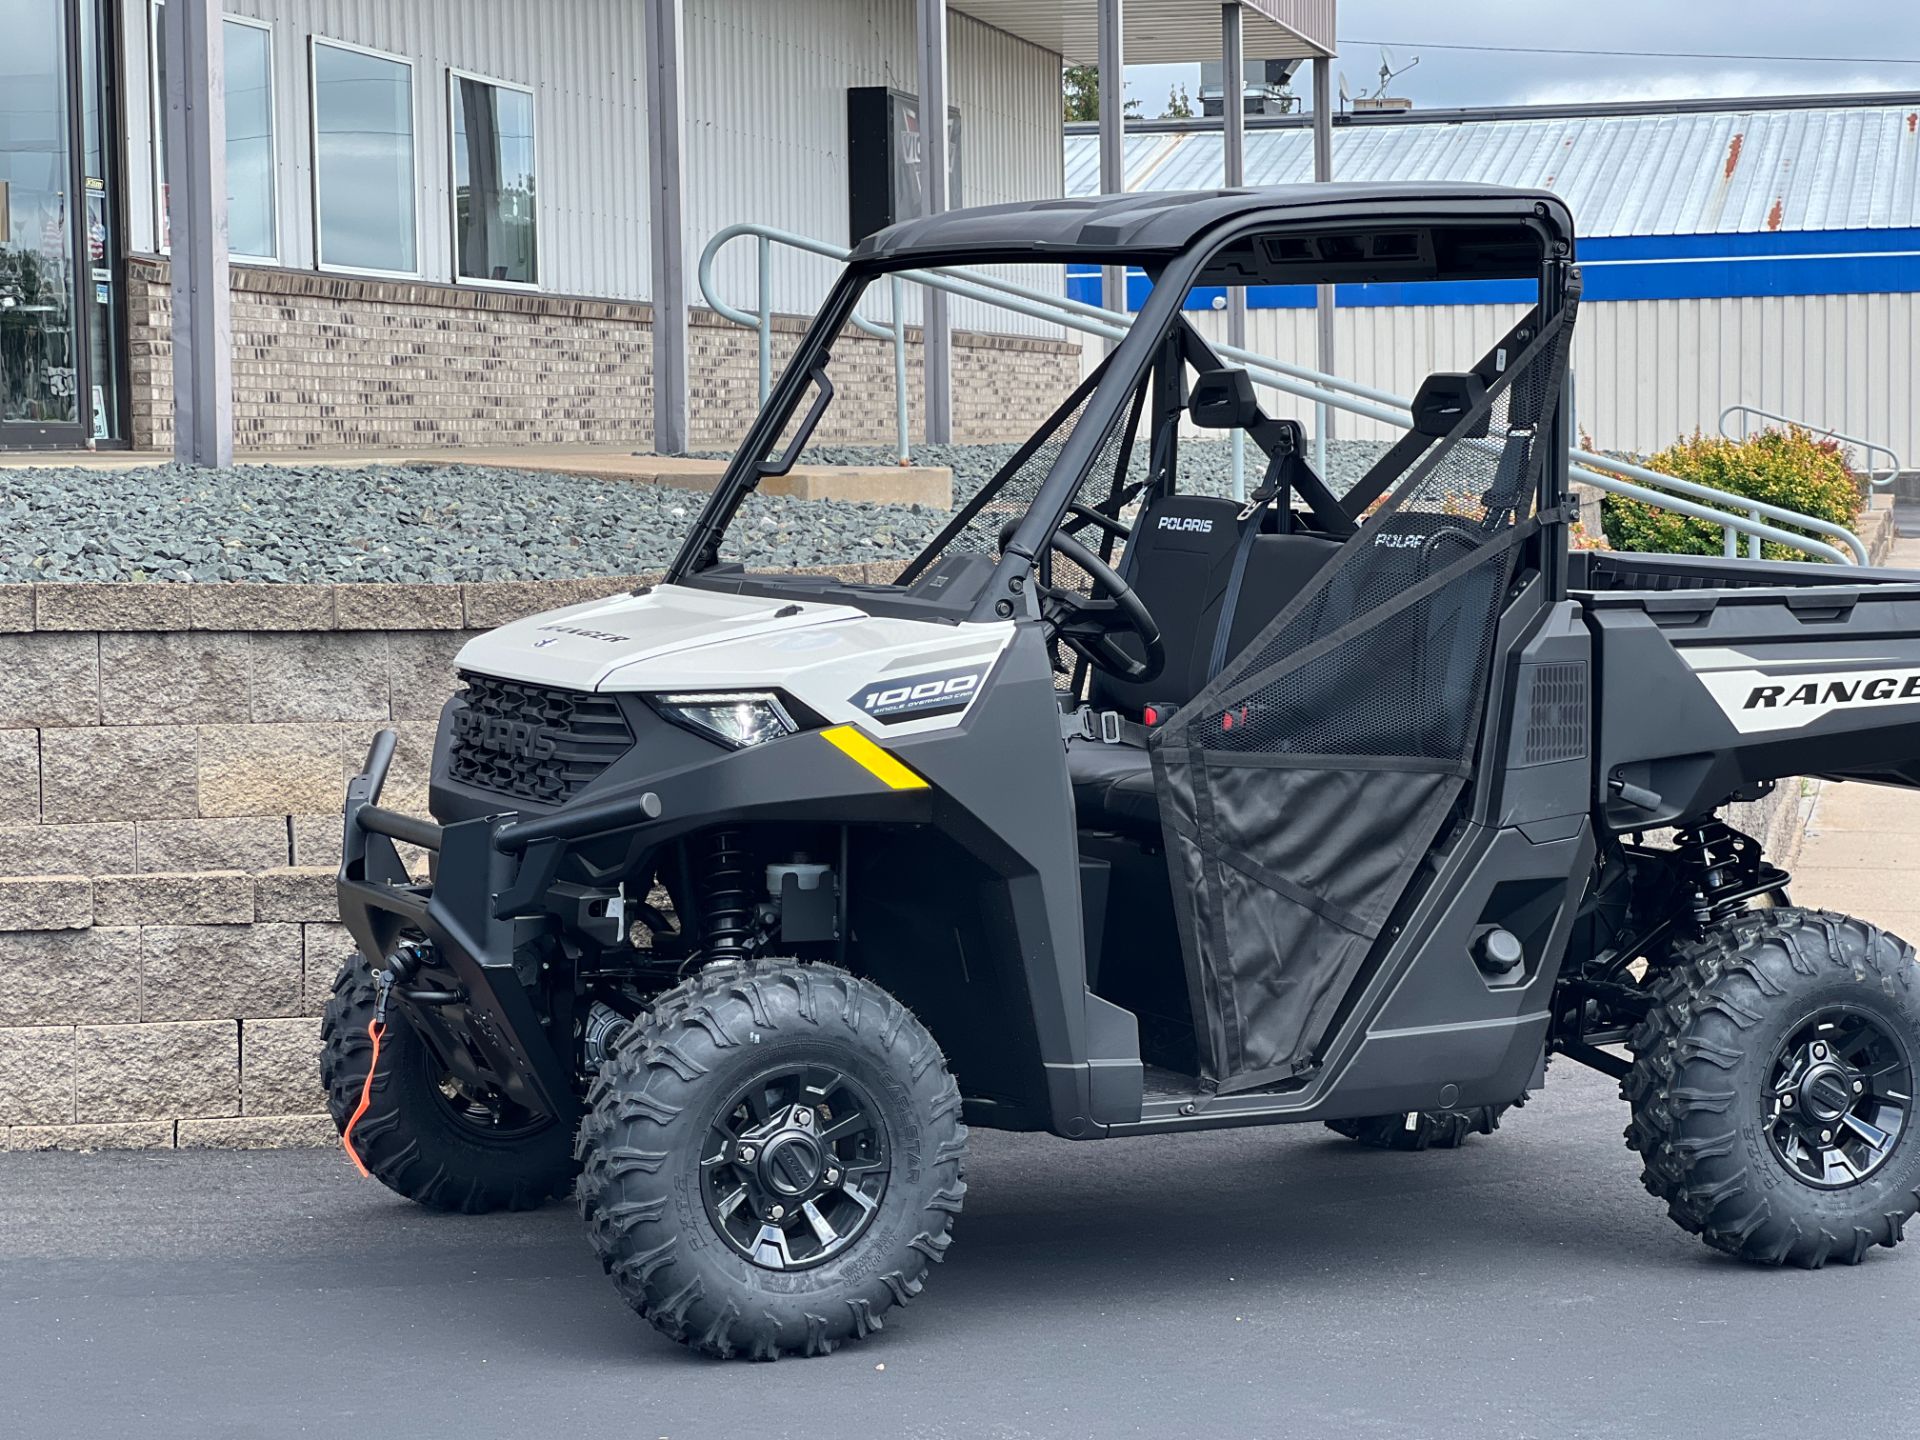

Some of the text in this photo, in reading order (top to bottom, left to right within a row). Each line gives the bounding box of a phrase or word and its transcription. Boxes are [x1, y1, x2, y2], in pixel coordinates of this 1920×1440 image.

[1157, 516, 1213, 533] POLARIS
[1375, 533, 1440, 549] POLAR
[864, 674, 978, 709] 1000
[873, 690, 973, 714] SINGLE OVERHEAD CAM
[450, 708, 557, 761] POLARIS
